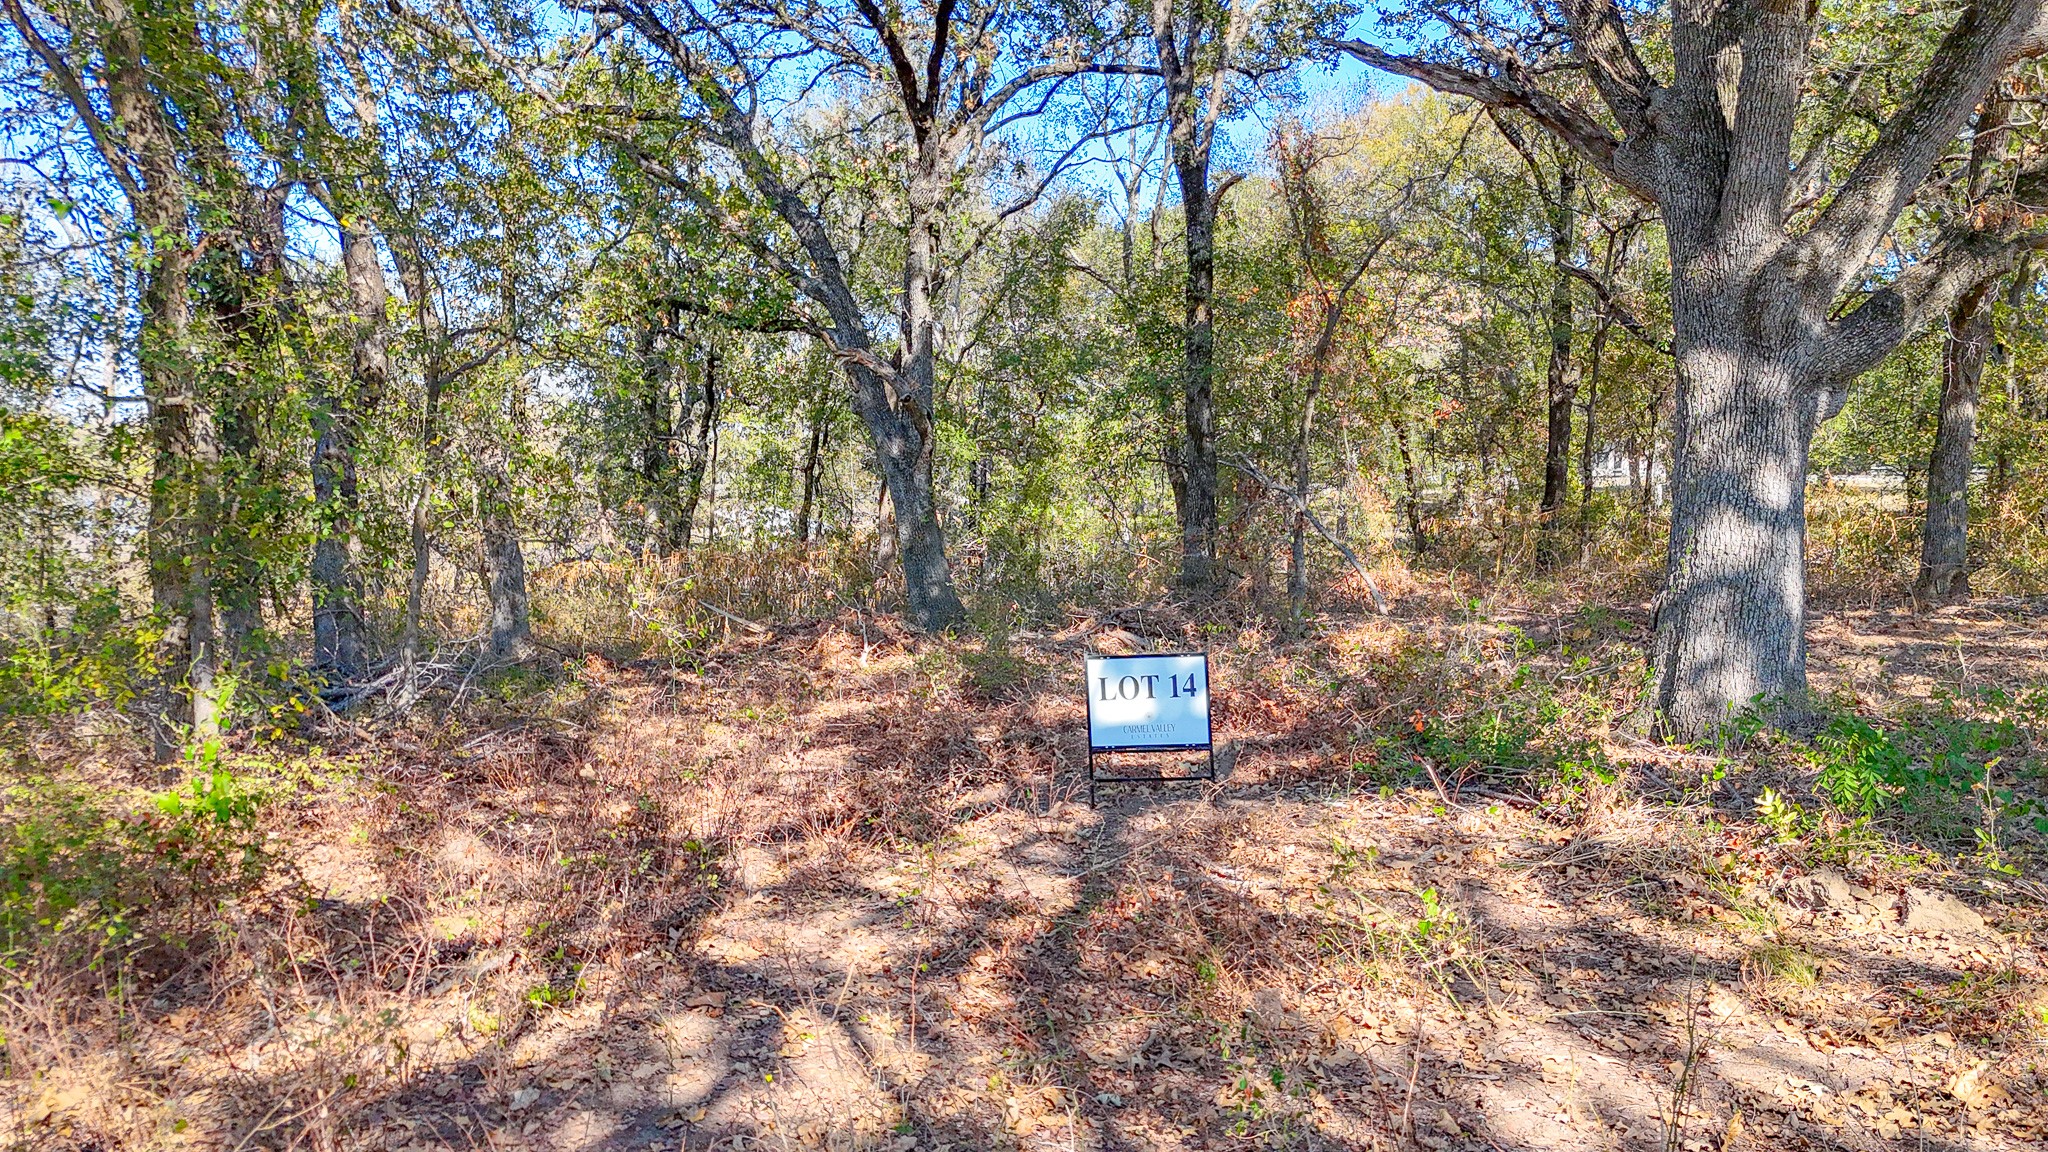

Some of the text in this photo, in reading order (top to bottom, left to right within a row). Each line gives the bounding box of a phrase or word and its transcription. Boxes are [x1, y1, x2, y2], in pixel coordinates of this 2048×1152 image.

[1098, 672, 1197, 701] LOT 14
[1123, 723, 1176, 734] CARMEL VALLEY
